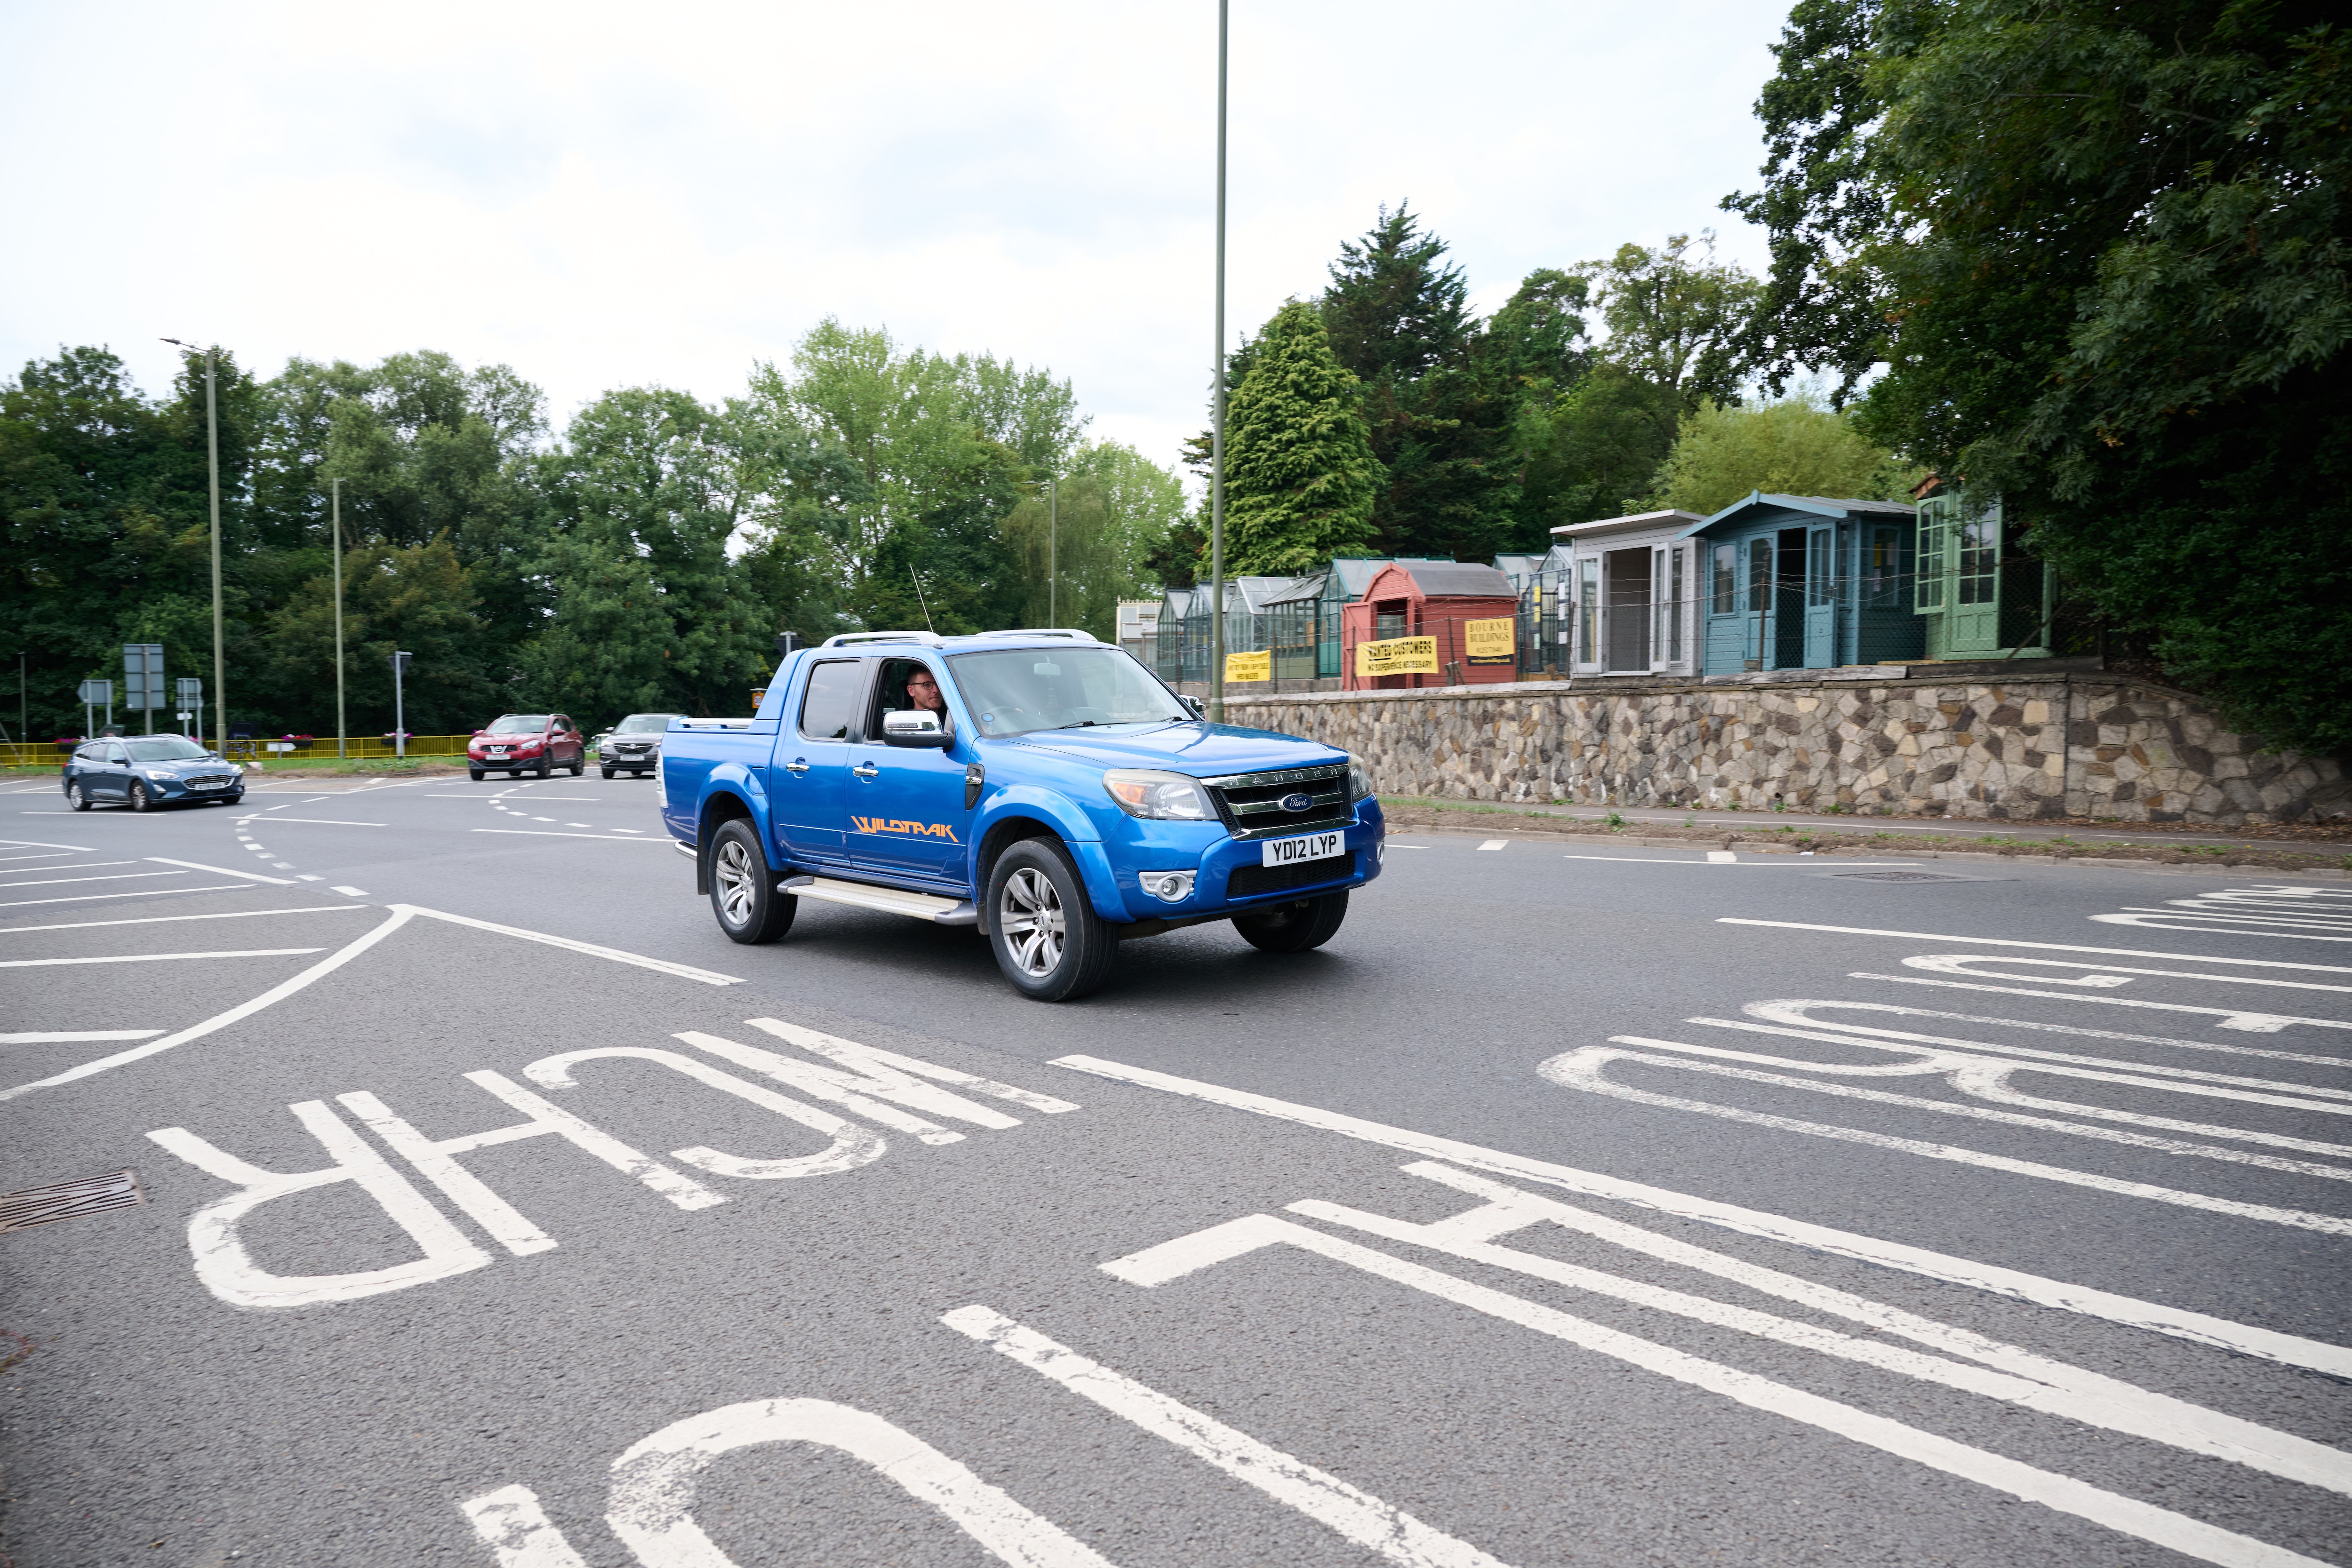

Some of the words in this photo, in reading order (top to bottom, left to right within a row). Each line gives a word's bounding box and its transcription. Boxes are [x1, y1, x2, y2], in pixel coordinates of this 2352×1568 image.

[1469, 621, 1509, 632] BOURNE
[1470, 632, 1510, 643] BUILDINGS
[1368, 644, 1391, 657] WANTED
[1392, 641, 1432, 656] CUSTOMERS
[1229, 768, 1338, 786] RANGER
[1290, 796, 1307, 807] Ford
[850, 815, 959, 843] WILDTRAK
[1273, 839, 1306, 861] YD12
[1310, 835, 1337, 856] LYP
